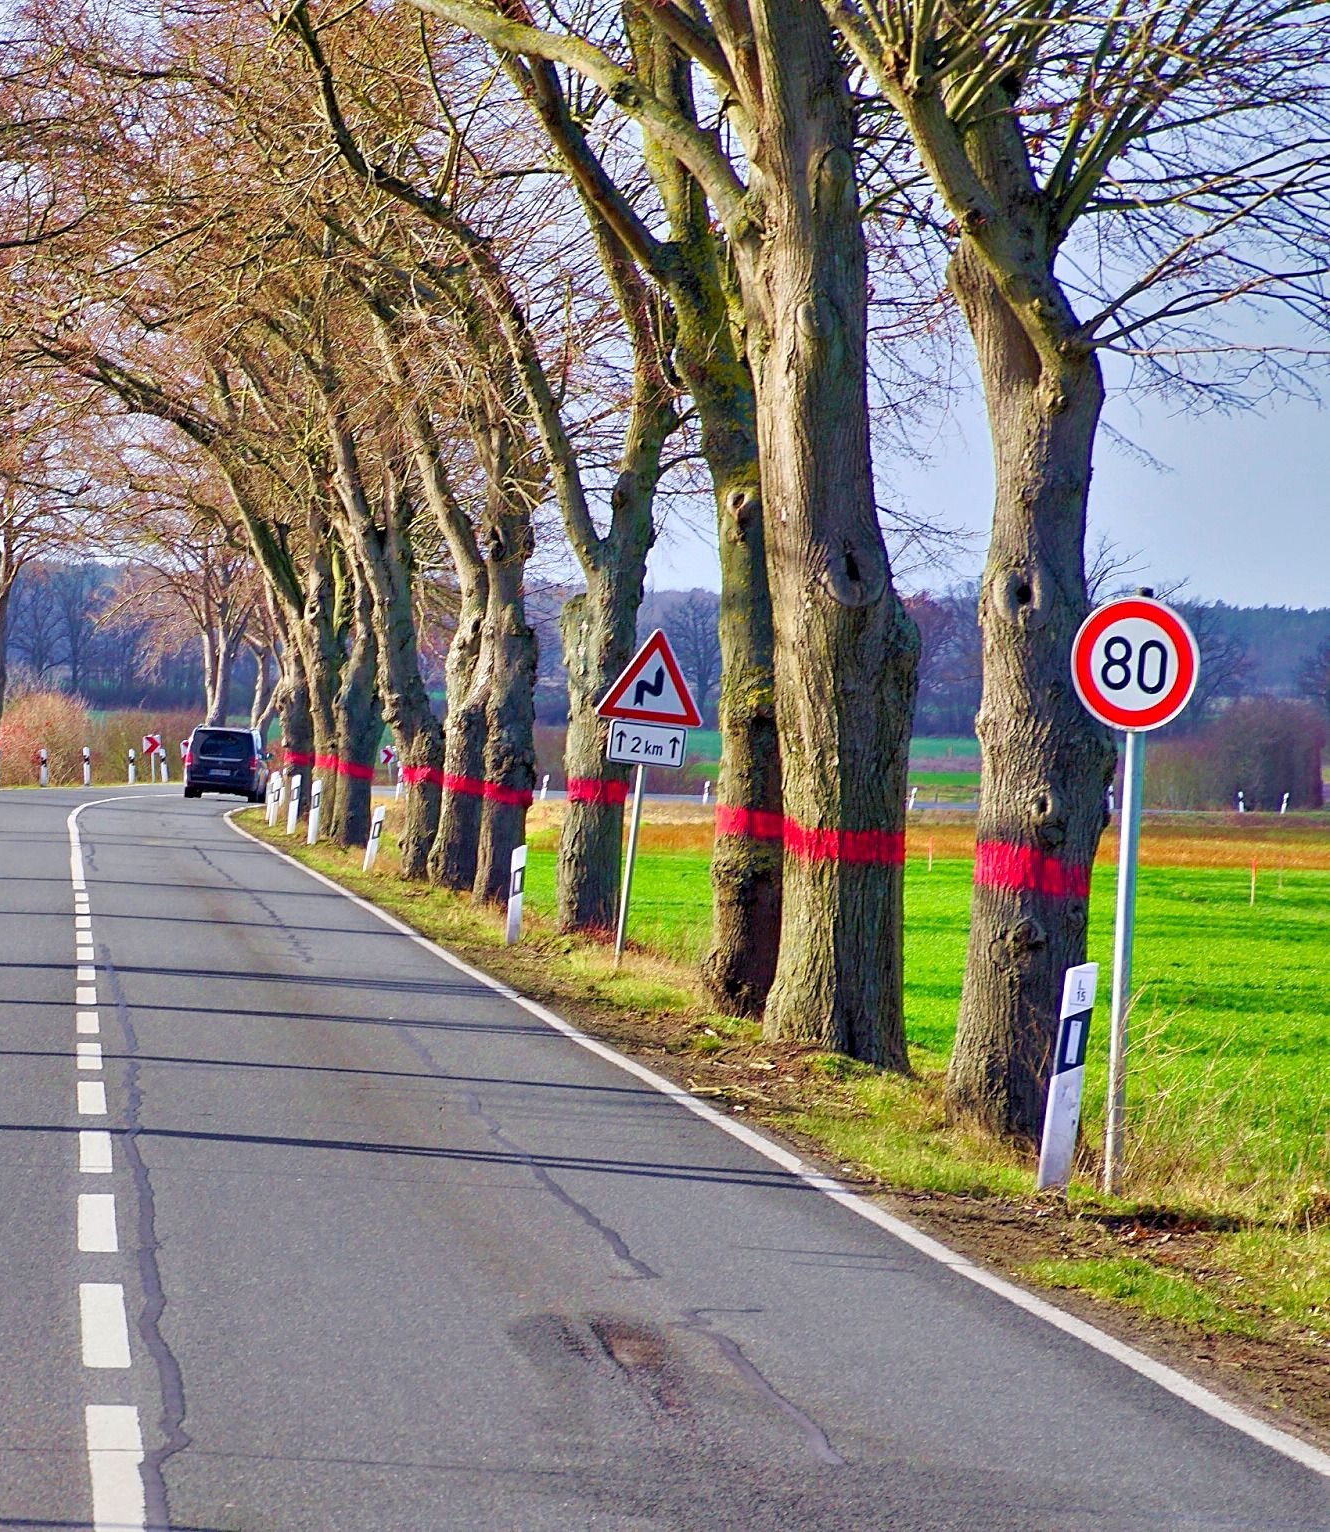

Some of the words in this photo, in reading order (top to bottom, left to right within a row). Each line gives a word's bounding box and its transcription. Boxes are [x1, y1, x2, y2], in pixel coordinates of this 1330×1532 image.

[1101, 636, 1168, 694] 80
[630, 736, 642, 754] 2
[644, 740, 663, 756] km
[1076, 991, 1086, 1001] 15
